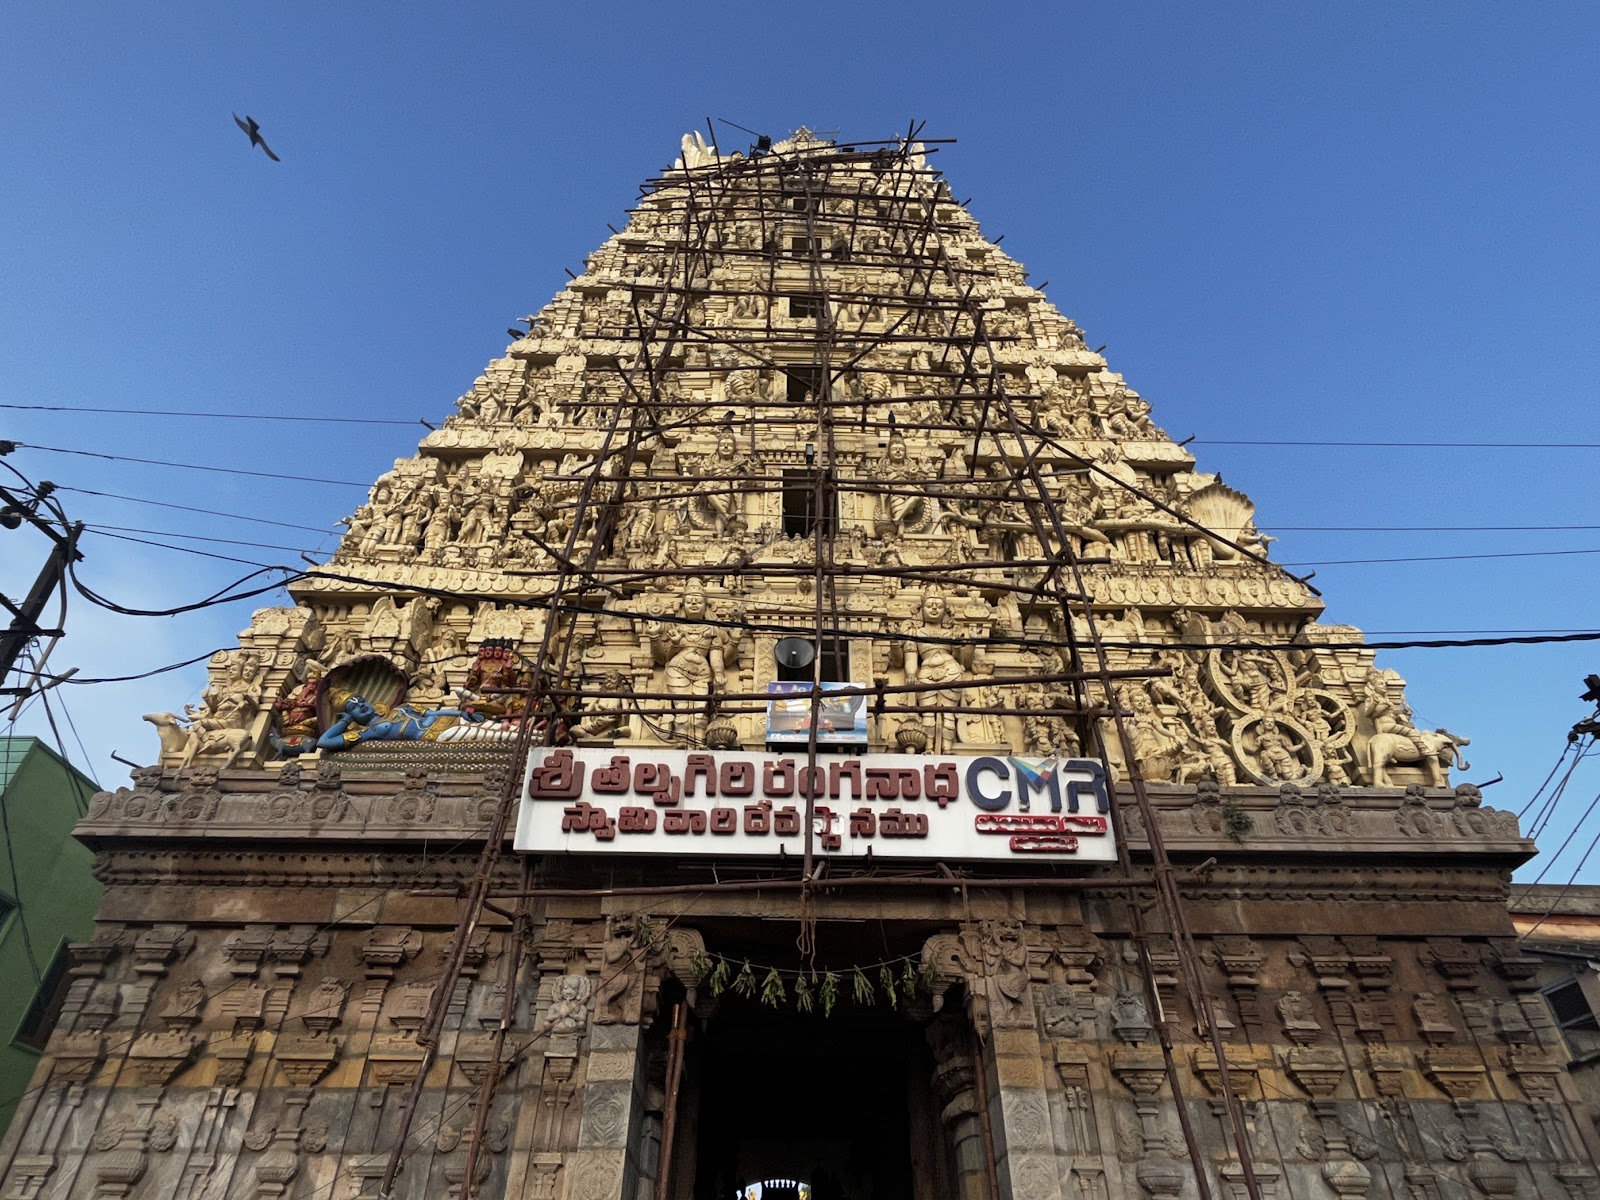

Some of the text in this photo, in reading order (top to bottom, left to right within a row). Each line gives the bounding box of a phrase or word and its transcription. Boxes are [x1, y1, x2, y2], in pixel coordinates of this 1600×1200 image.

[529, 749, 586, 799] శ్రీ
[591, 753, 755, 806] తల్పగిరి
[966, 754, 1110, 814] CMR
